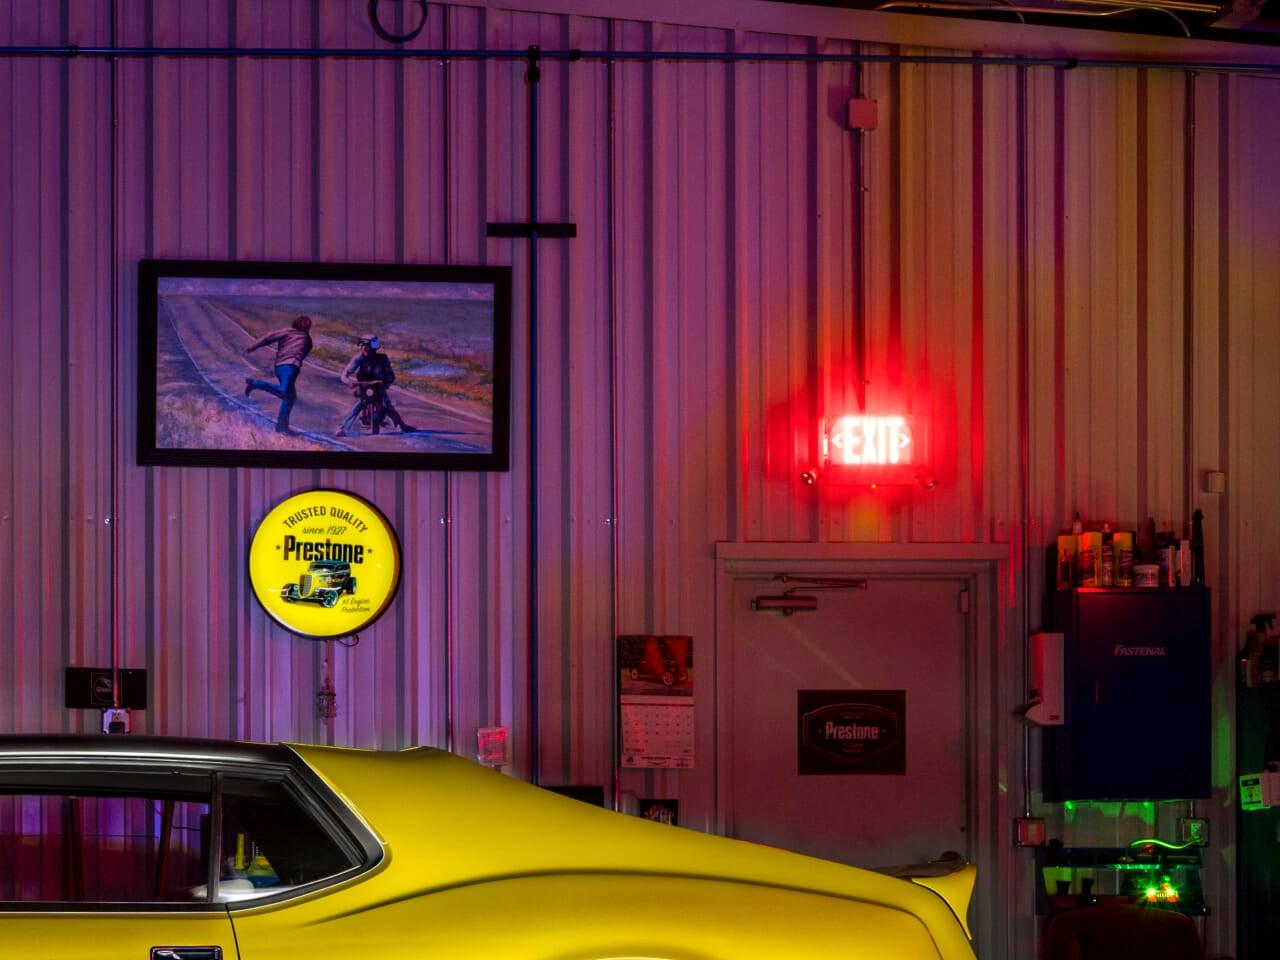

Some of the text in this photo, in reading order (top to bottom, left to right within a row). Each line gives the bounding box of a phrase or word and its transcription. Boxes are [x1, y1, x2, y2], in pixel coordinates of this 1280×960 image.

[844, 416, 903, 464] EXIT
[283, 506, 368, 533] TRUSTED QUALITY
[302, 526, 347, 536] since 1927
[283, 535, 364, 564] Prestone
[825, 720, 879, 740] Prestone
